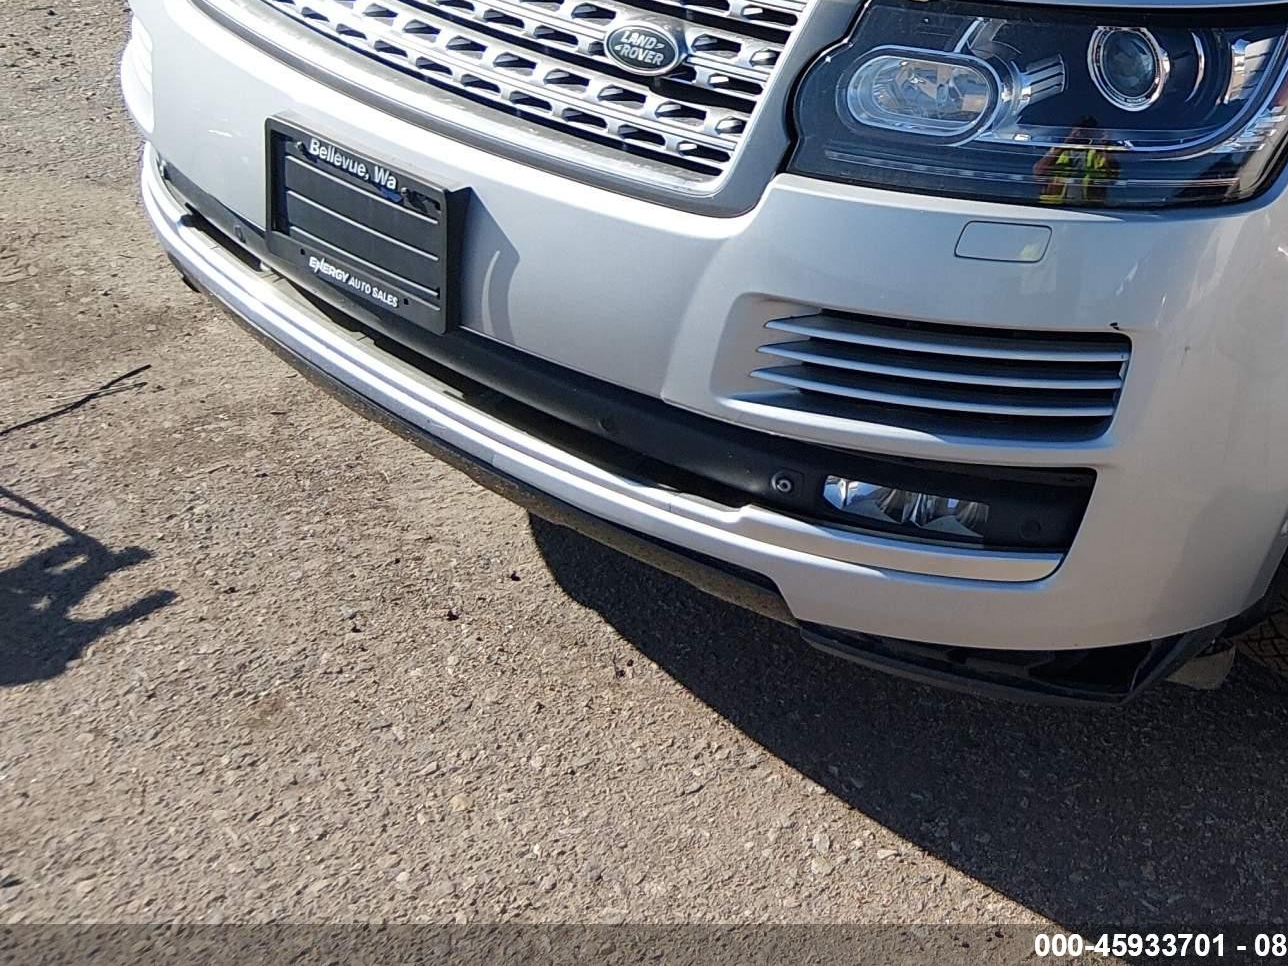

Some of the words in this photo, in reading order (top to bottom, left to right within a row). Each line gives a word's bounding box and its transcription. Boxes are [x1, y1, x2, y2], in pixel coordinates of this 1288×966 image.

[620, 30, 658, 50] LAND
[620, 43, 665, 66] ROVER
[309, 138, 370, 181] Bellevue,
[373, 165, 398, 190] Wa
[308, 256, 350, 283] ENERGY
[348, 276, 372, 295] AUTO
[372, 287, 399, 308] SALES
